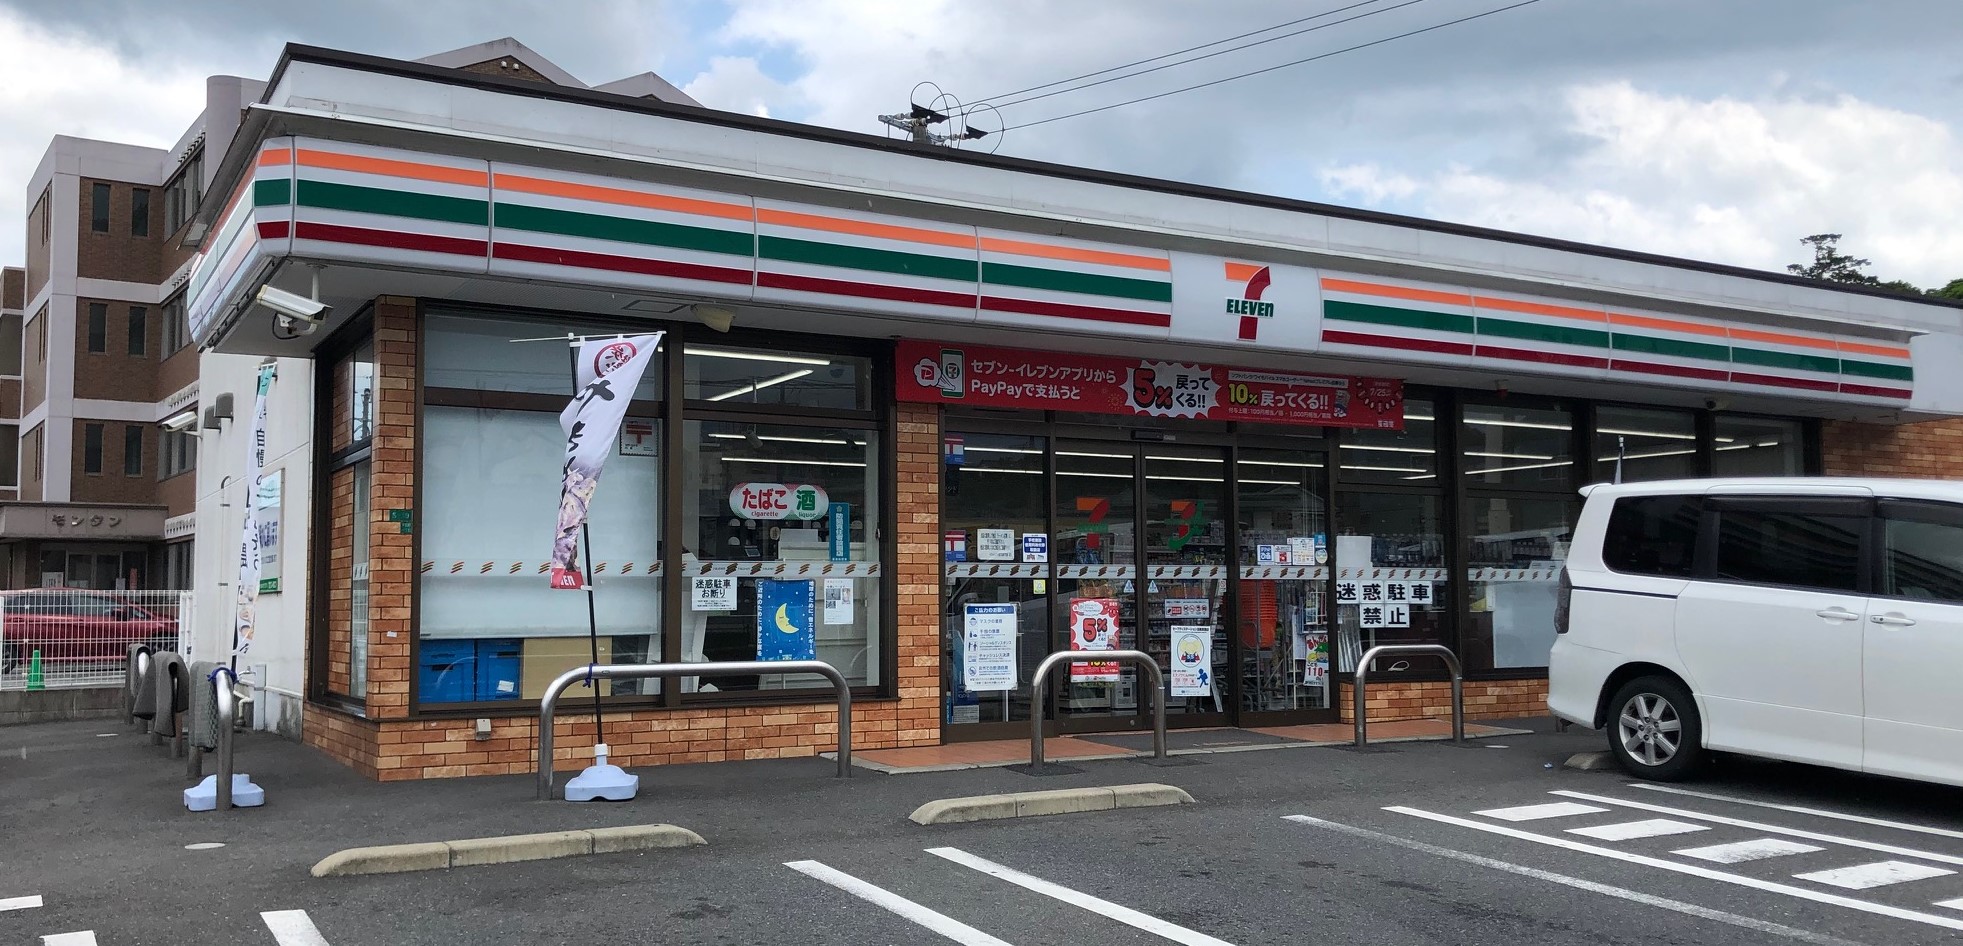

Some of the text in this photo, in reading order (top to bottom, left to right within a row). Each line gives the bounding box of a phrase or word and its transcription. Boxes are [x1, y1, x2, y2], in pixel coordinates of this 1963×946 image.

[1225, 261, 1271, 340] 7
[971, 380, 1081, 400] PayPayで支払うと
[1133, 368, 1173, 410] 5%
[1175, 374, 1211, 391] 戻って
[1228, 383, 1329, 410] 10% 戻ってくる!!
[742, 487, 816, 511] たばこ 酒
[52, 514, 122, 527] モンタン
[695, 578, 731, 589] 迷惑駐車
[1336, 582, 1430, 601] 迷惑駐車
[701, 589, 726, 598] お断り
[1362, 606, 1407, 625] 禁止
[1082, 617, 1108, 643] 5%
[1307, 667, 1323, 677] 110
